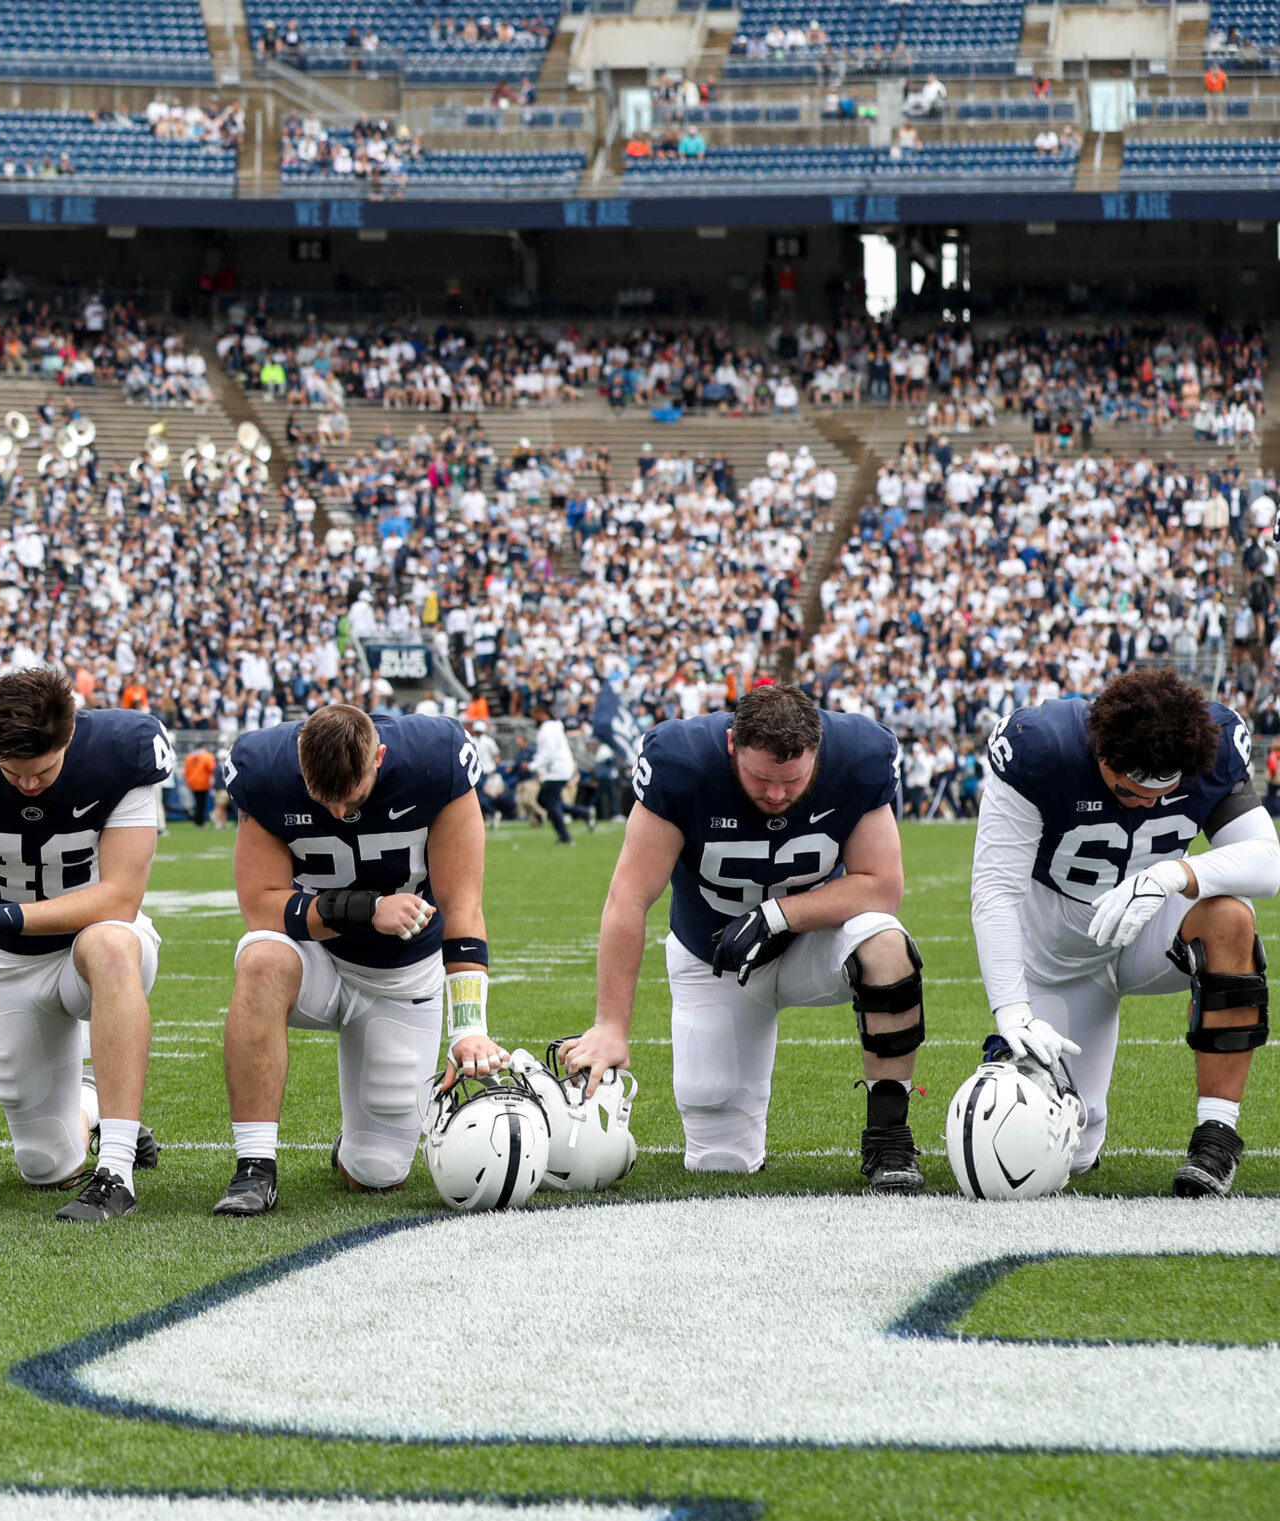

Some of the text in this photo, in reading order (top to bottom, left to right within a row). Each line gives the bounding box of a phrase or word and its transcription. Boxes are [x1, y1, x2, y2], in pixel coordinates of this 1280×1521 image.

[28, 195, 97, 224] WE ARE
[294, 200, 365, 228] WE ARE
[562, 199, 632, 227] WE ARE
[830, 194, 900, 223] WE ARE
[1101, 190, 1171, 220] WE ARE
[379, 661, 428, 678] BAND
[381, 648, 426, 663] BLUE
[288, 826, 429, 899] 27
[1048, 814, 1197, 905] 66
[699, 832, 840, 917] 52
